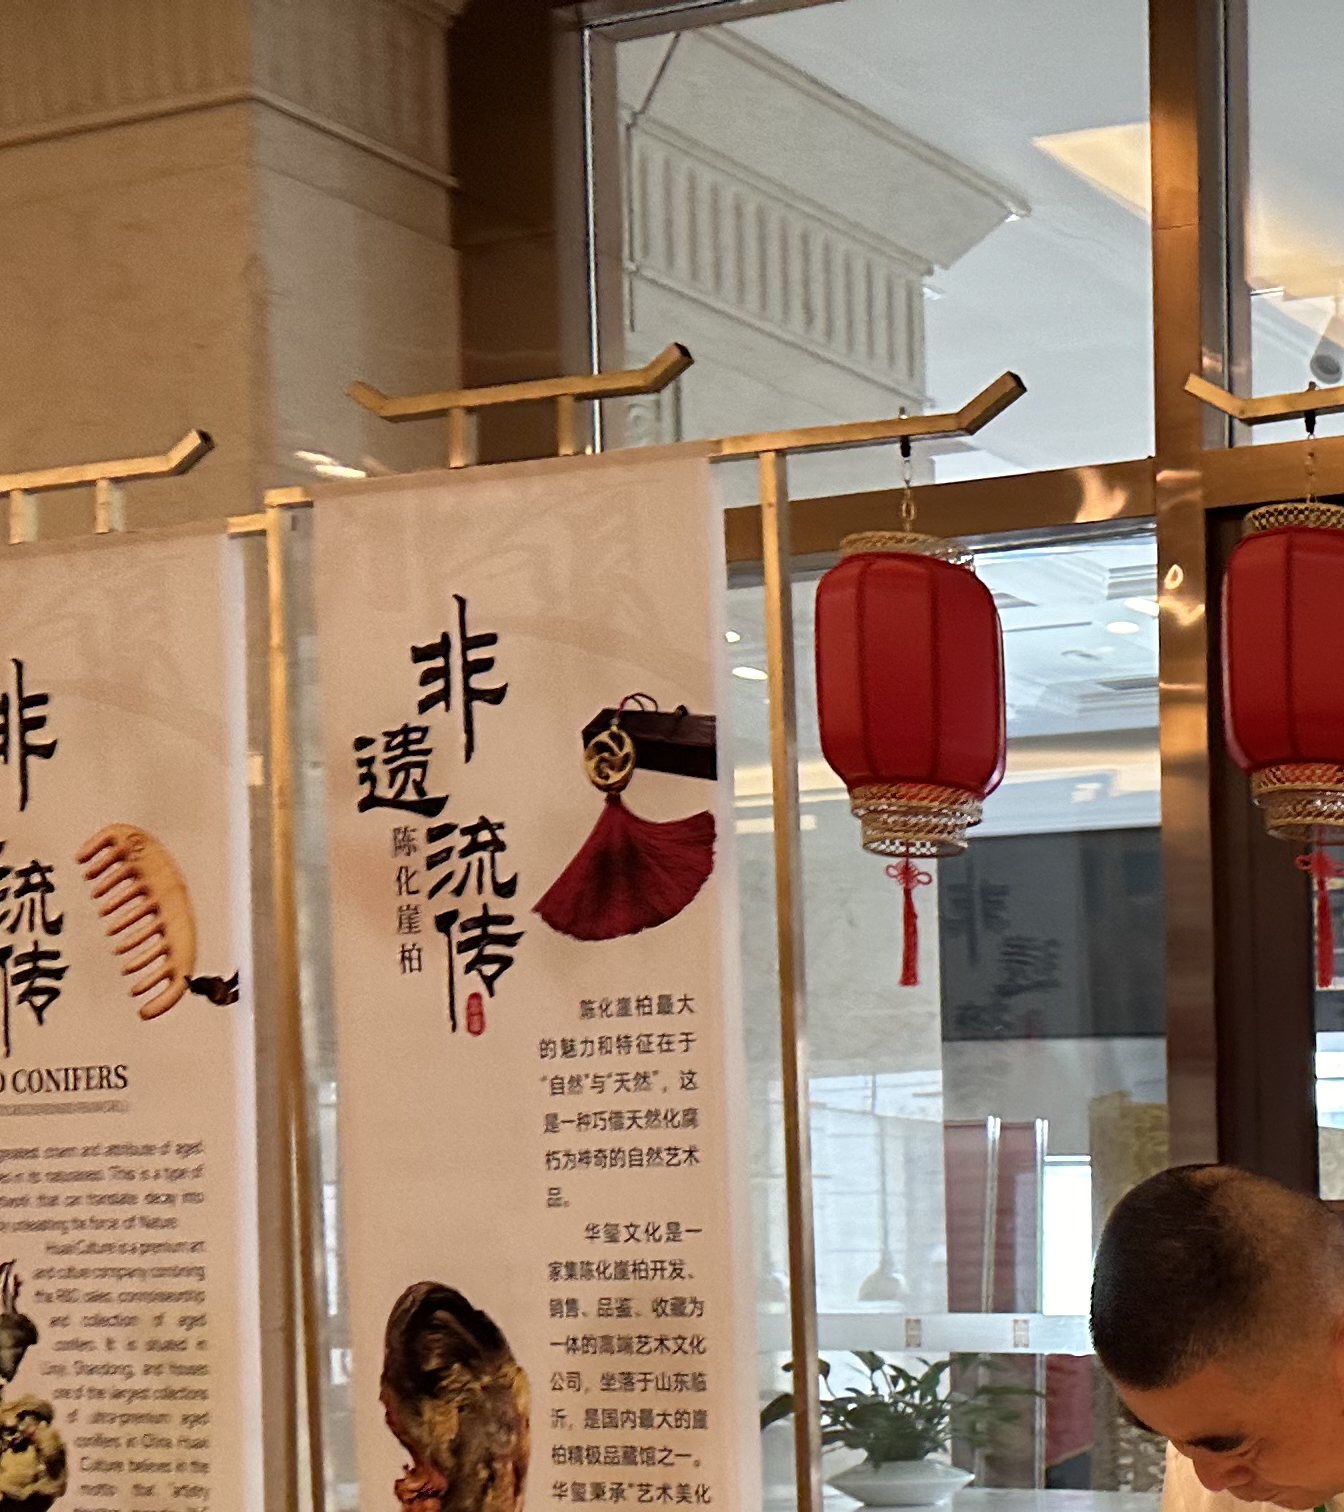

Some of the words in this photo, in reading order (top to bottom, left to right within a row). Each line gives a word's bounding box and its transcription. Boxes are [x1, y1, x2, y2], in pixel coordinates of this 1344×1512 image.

[390, 825, 424, 977] 陈化崖柏
[12, 1064, 128, 1094] CONIFERS
